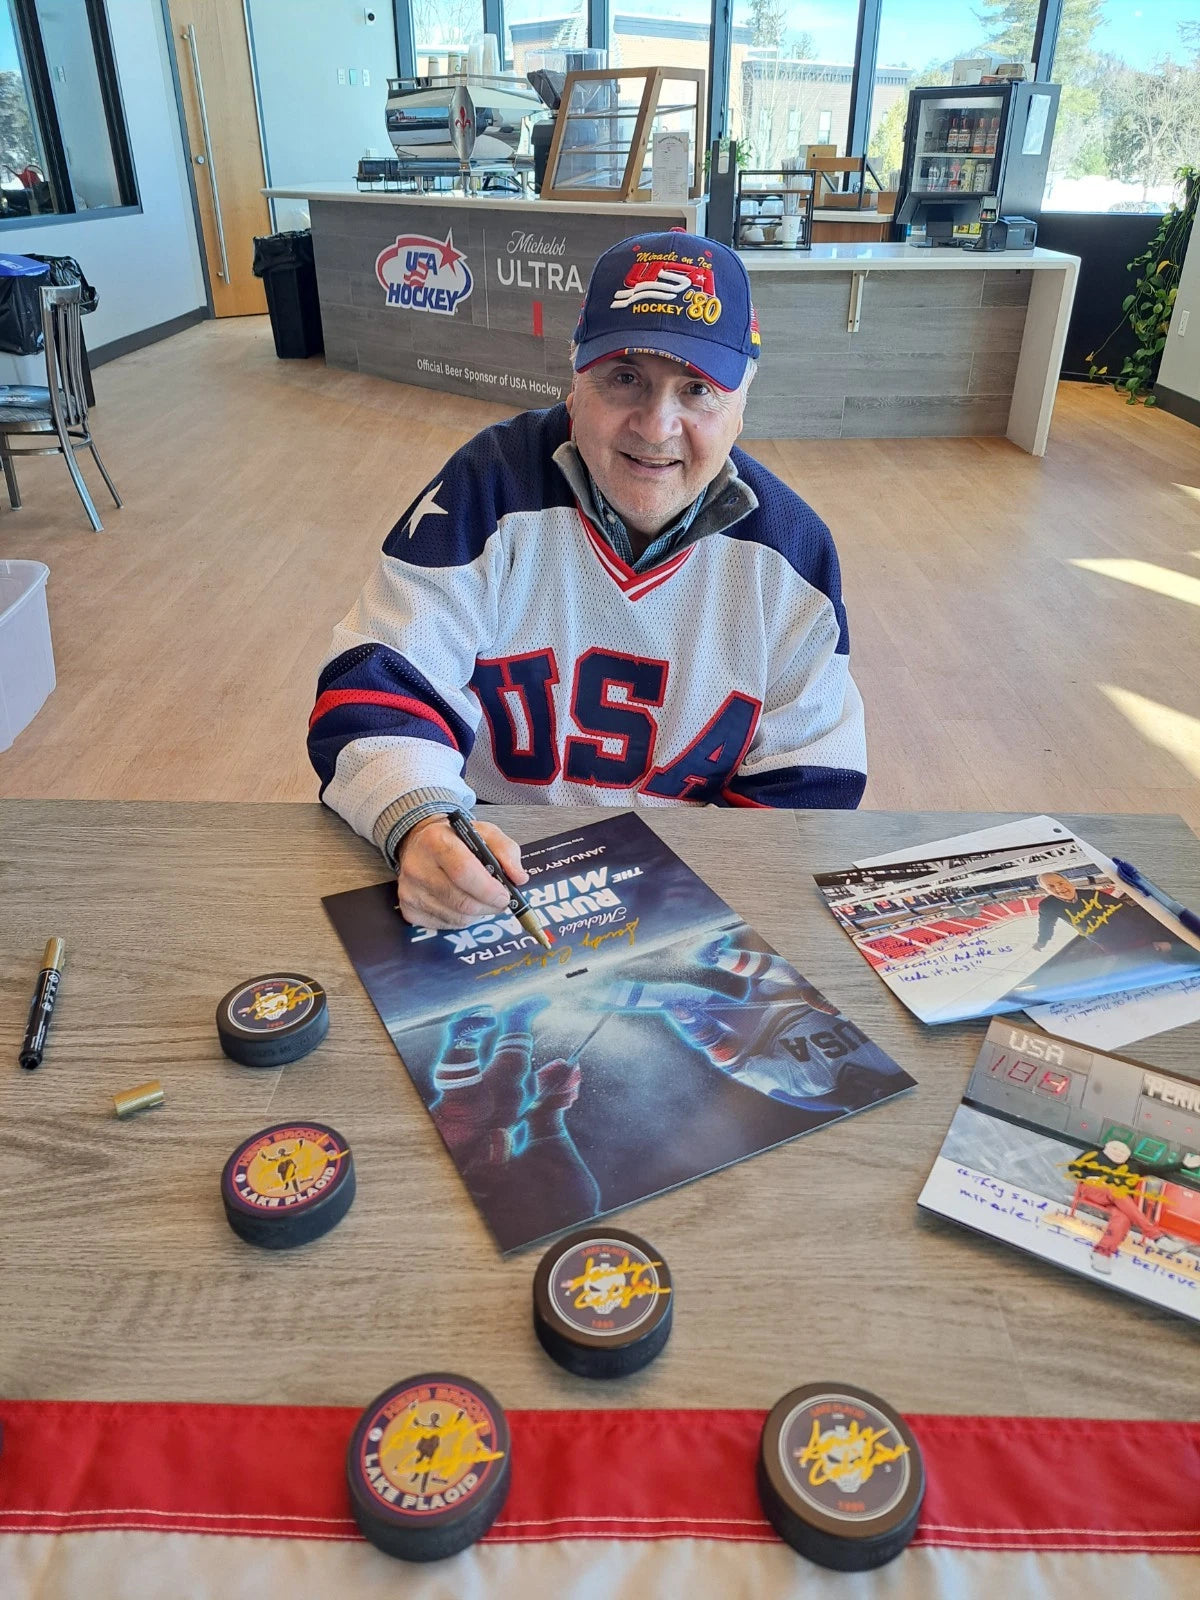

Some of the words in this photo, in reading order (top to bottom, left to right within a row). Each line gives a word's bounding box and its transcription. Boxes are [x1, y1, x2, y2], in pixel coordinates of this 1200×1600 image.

[506, 230, 566, 256] Michelob
[404, 251, 438, 288] USA
[496, 257, 584, 293] ULTRA
[636, 251, 678, 263] Miracle
[681, 257, 694, 265] on
[697, 256, 713, 269] Ice
[388, 282, 459, 313] HOCKEY
[632, 303, 684, 316] HOCKEY
[416, 359, 444, 374] Official
[445, 364, 463, 378] Beer
[464, 367, 498, 385] Sponsor
[499, 374, 508, 386] of
[510, 376, 528, 391] USA
[529, 380, 562, 399] Hockey
[468, 646, 763, 801] USA
[545, 845, 607, 871] JANUARY
[611, 866, 644, 884] THE
[545, 887, 622, 923] RUN
[558, 906, 627, 937] Michelob
[458, 935, 539, 966] ULTRA
[778, 1022, 870, 1063] USA
[1008, 1030, 1065, 1066] USA
[240, 1186, 280, 1207] LAKE
[1131, 1256, 1197, 1289] believe
[364, 1452, 400, 1504] LAKE
